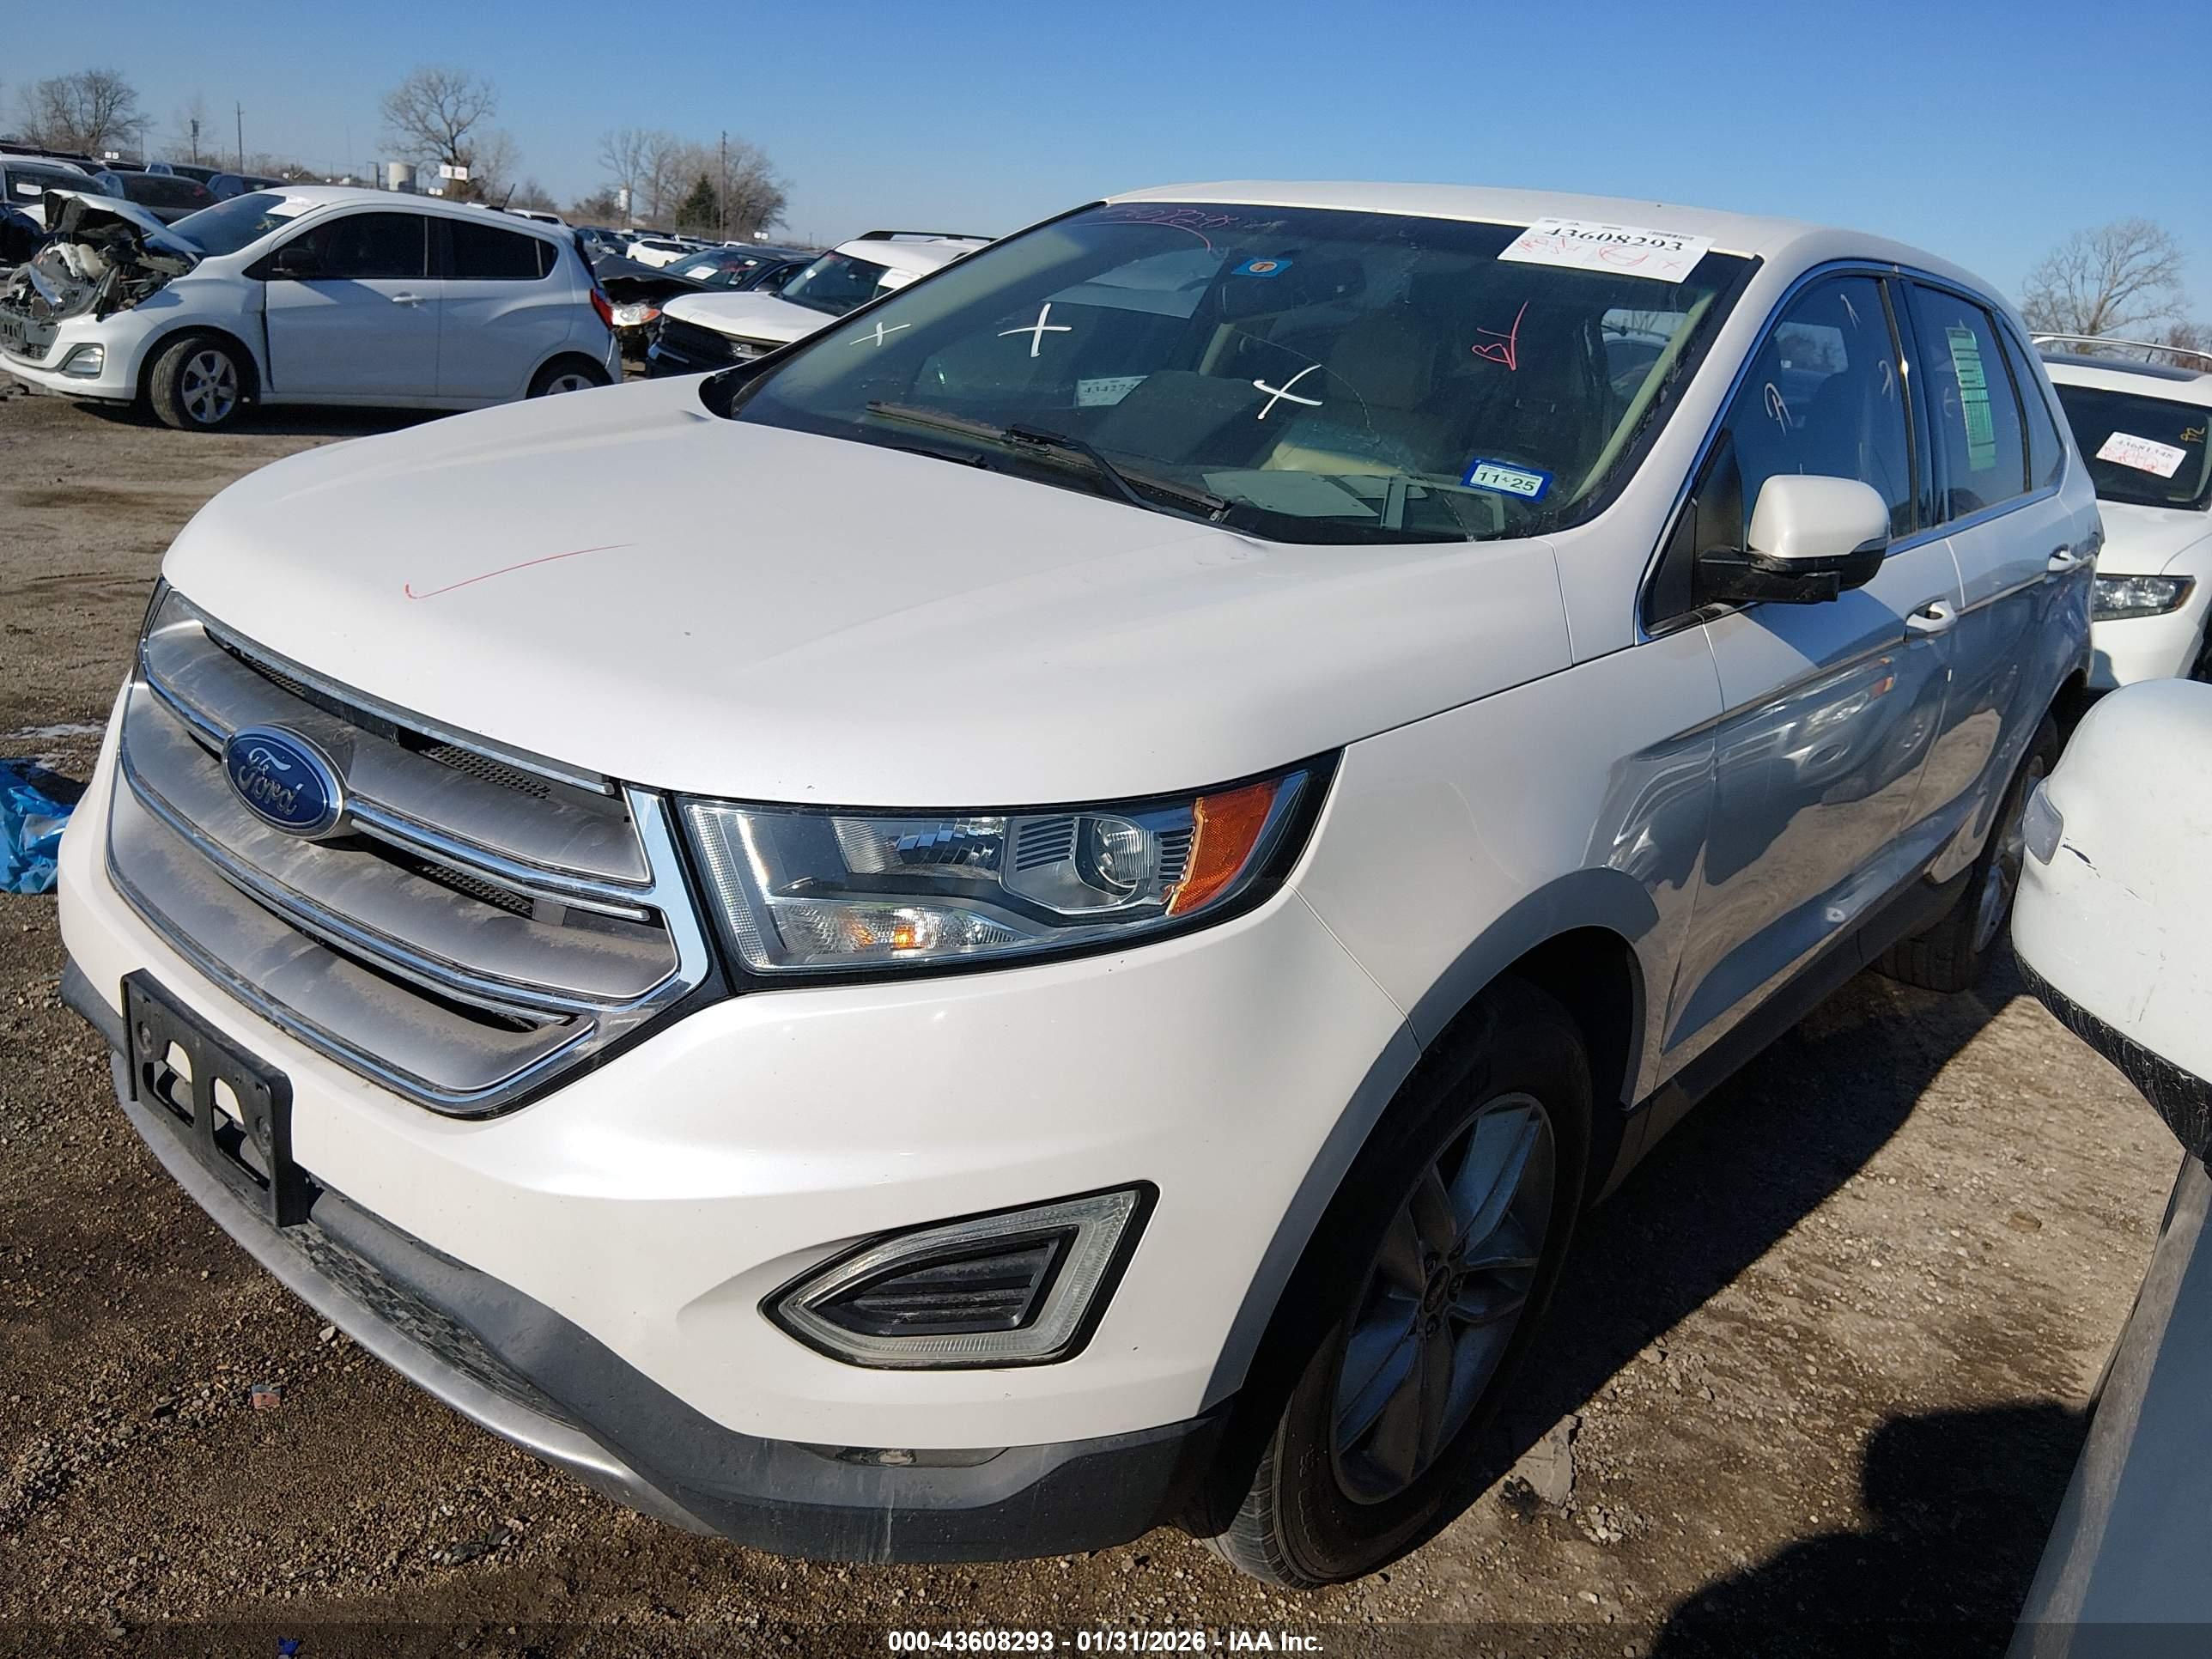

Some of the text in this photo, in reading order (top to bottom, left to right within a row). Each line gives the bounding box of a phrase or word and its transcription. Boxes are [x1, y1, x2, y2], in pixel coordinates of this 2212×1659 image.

[1544, 227, 1683, 252] 43608293
[1479, 471, 1500, 483] 11
[1510, 477, 1536, 491] 25
[237, 746, 304, 816] Ford
